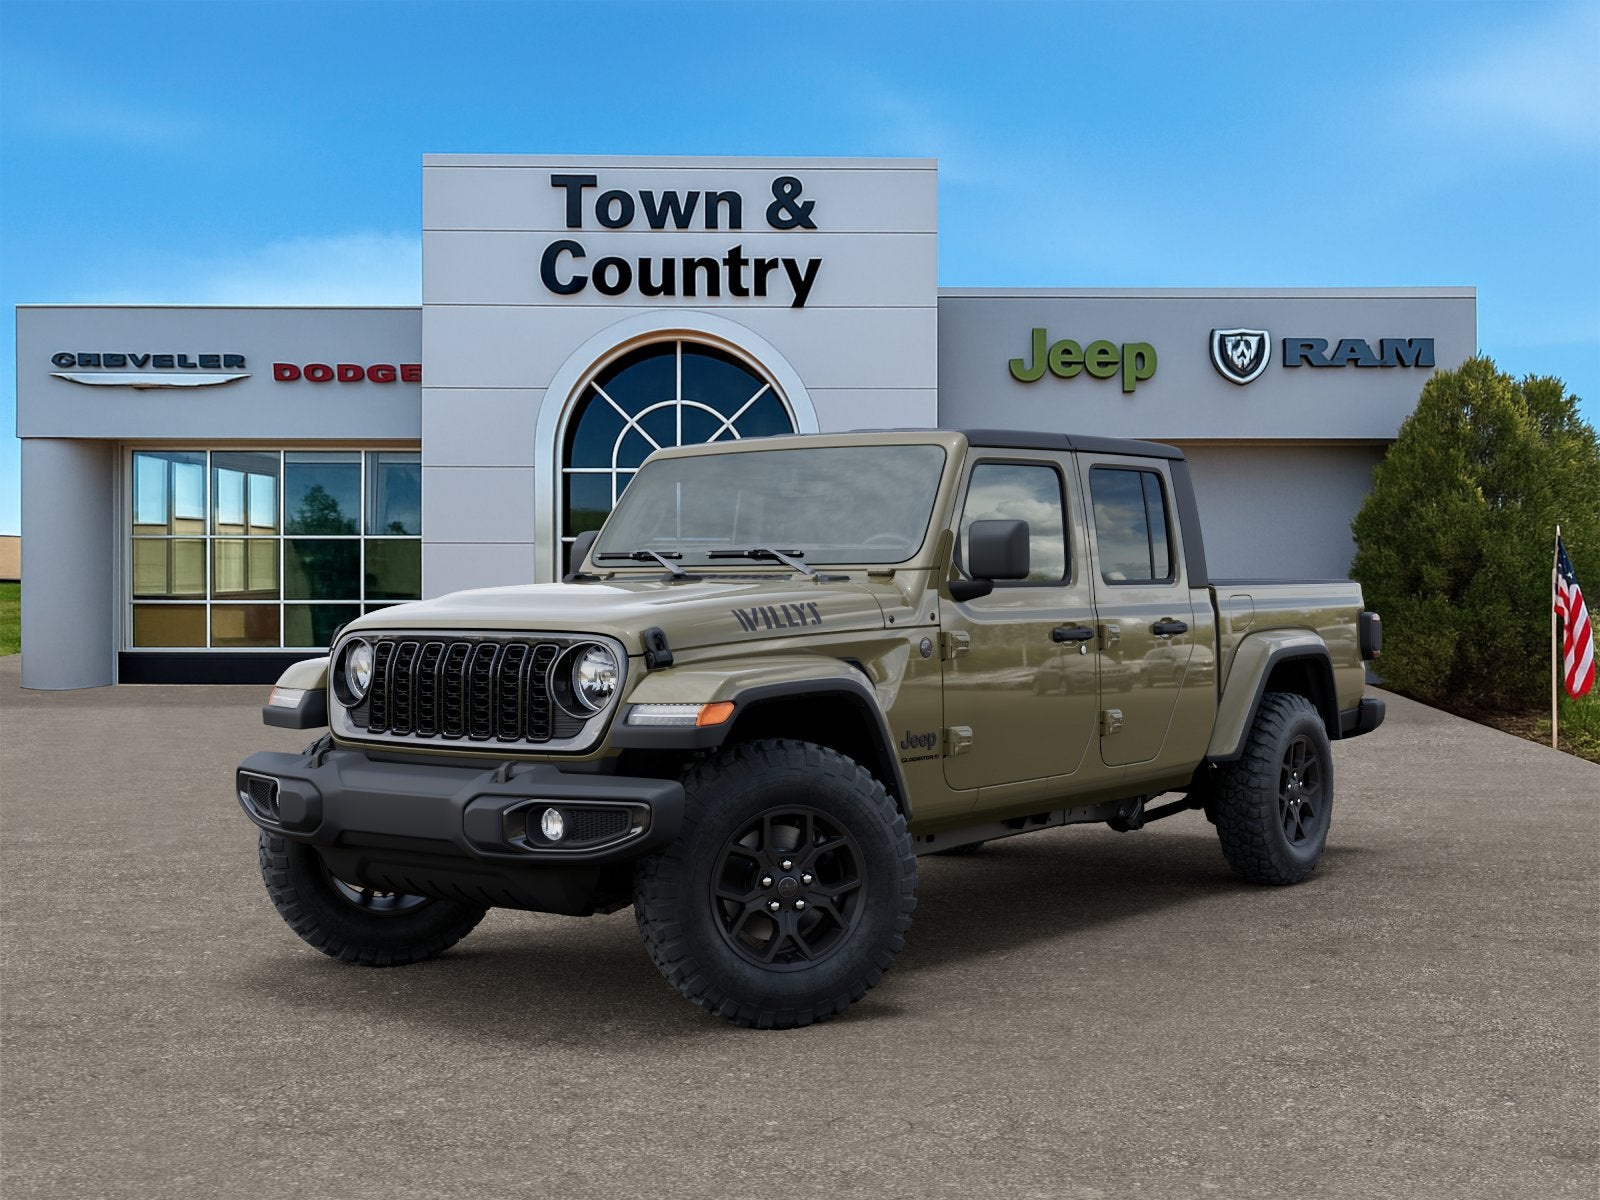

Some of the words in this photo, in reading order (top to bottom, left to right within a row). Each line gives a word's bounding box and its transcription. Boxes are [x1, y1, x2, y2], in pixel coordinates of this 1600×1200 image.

[550, 174, 742, 229] Town
[765, 176, 818, 230] &
[540, 239, 823, 308] Country
[1008, 327, 1157, 392] Jeep
[1281, 337, 1436, 368] RAM
[273, 363, 422, 382] DODGE
[731, 602, 822, 632] WILLYS
[901, 729, 937, 750] Jeep
